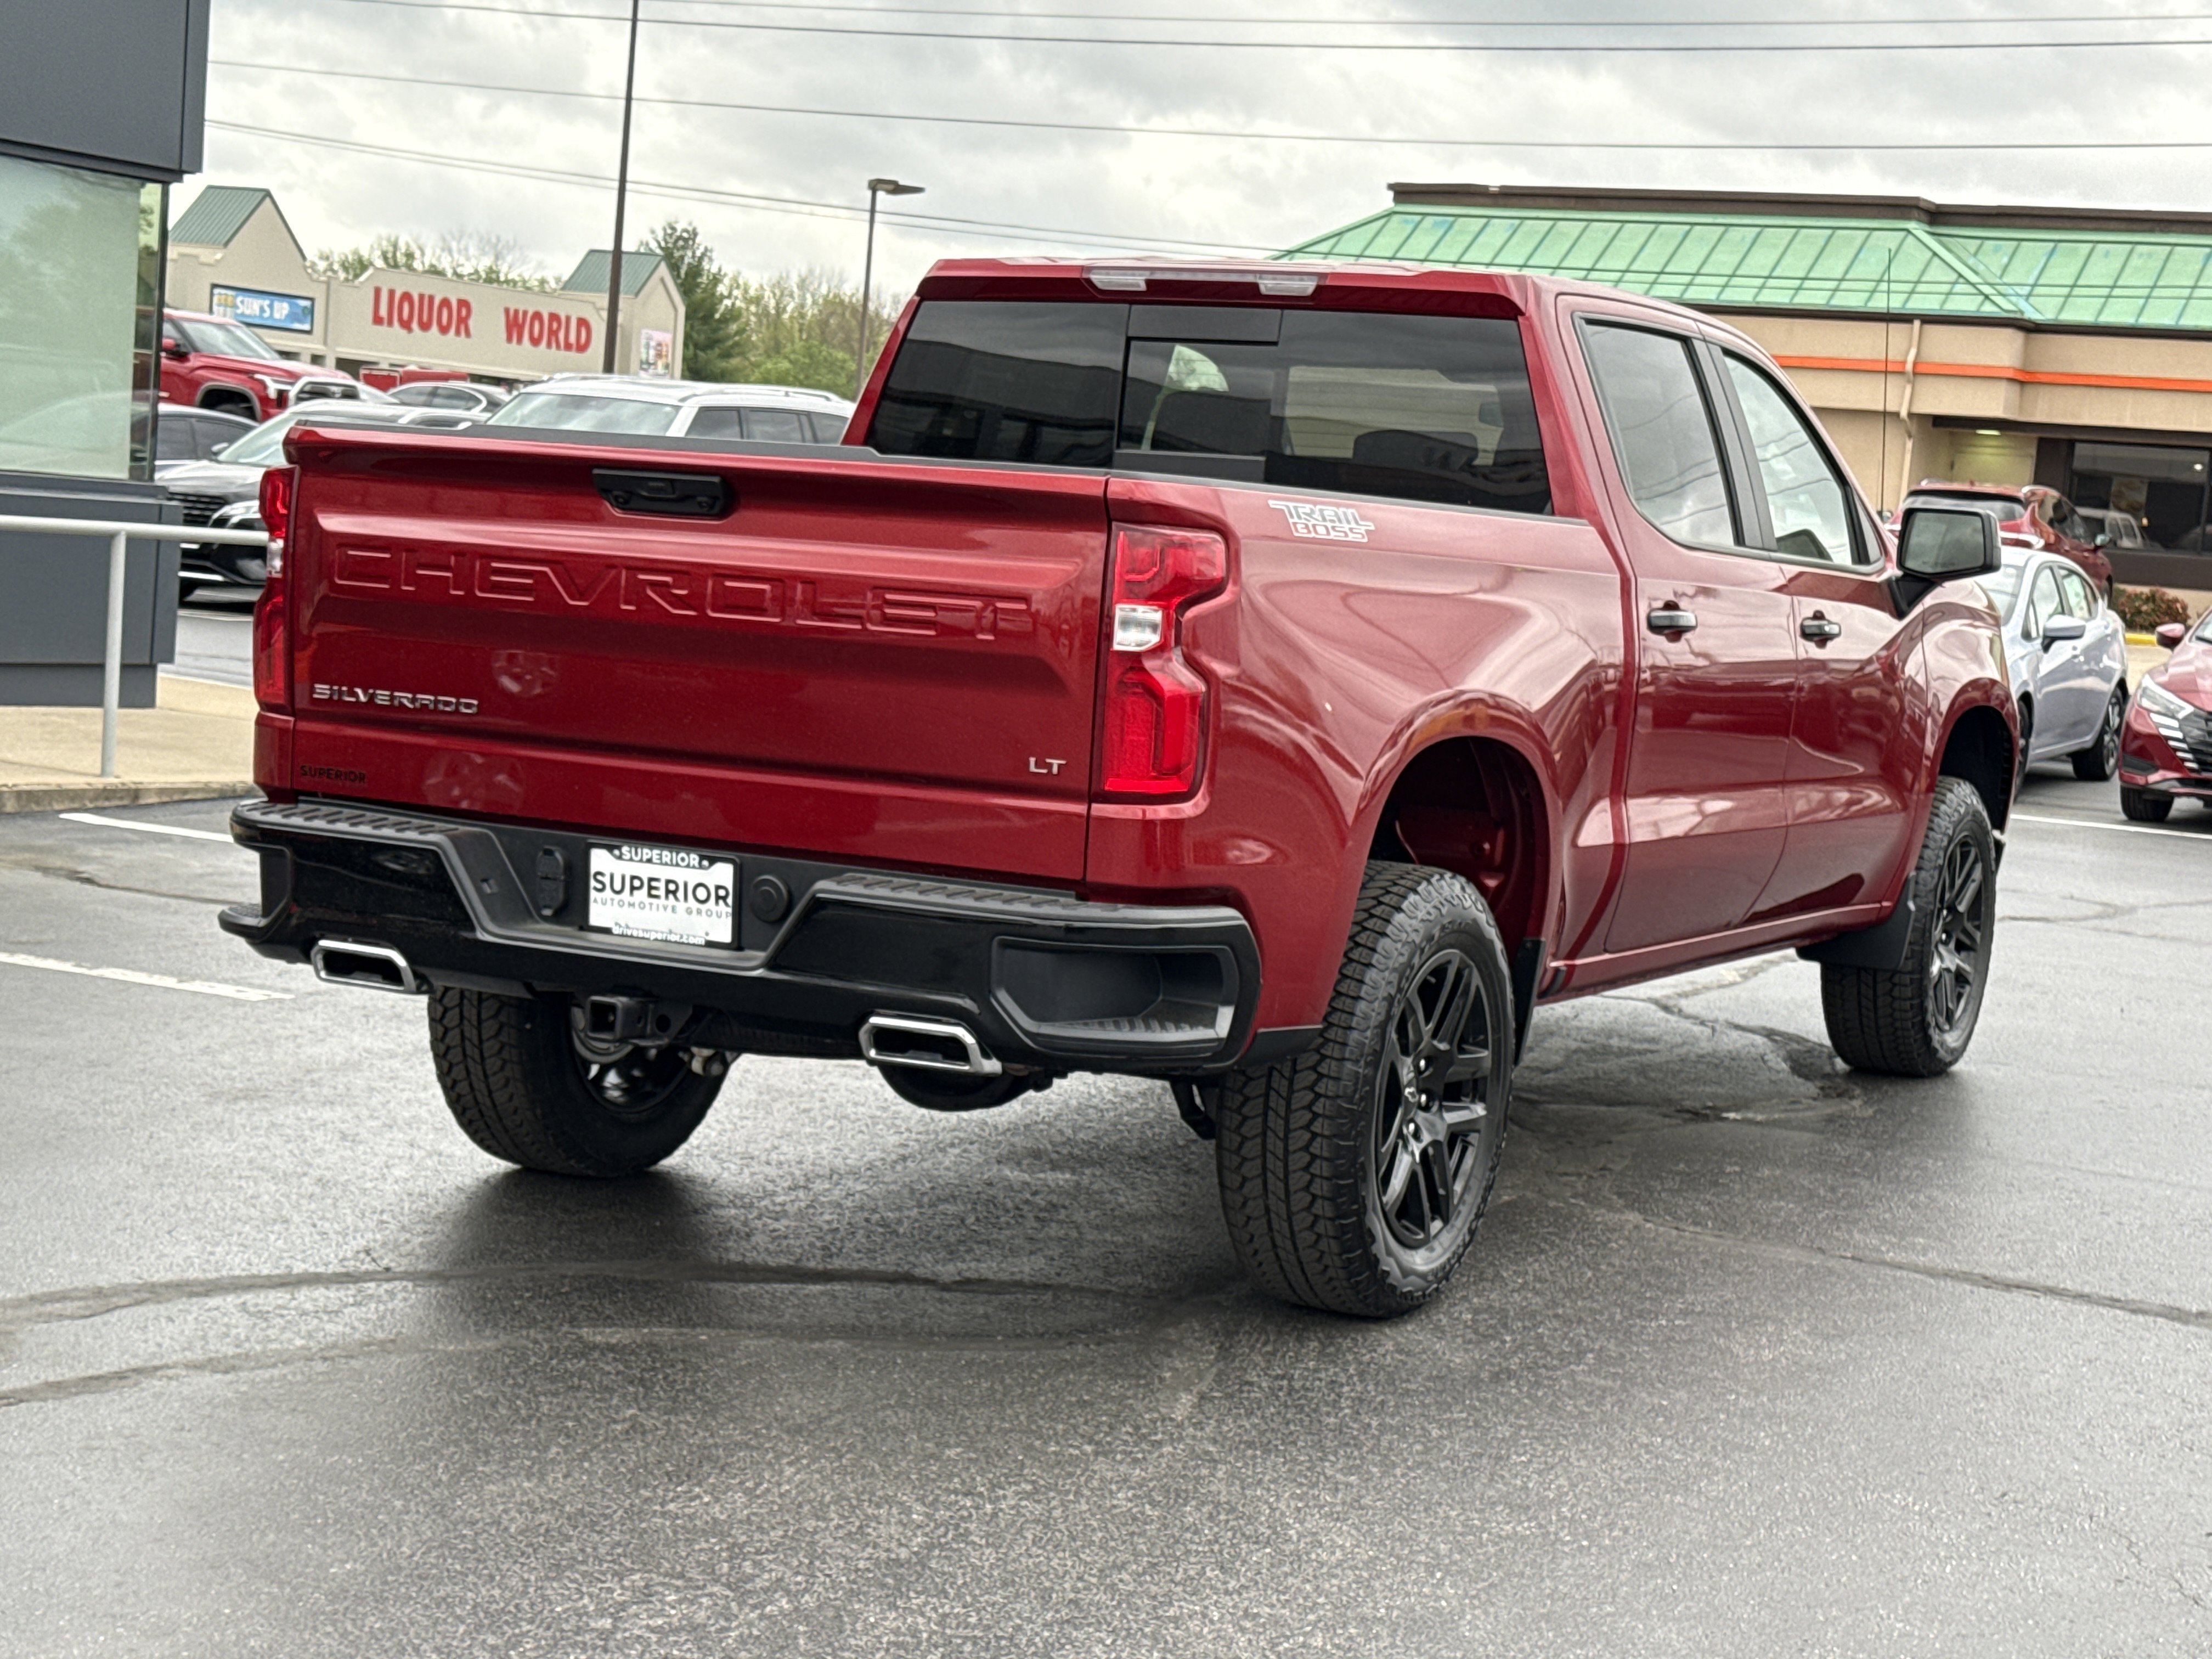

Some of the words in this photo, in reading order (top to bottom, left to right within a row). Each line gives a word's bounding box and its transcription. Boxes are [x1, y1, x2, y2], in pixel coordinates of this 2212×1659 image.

[235, 296, 270, 318] SUN'S
[273, 301, 289, 320] UP
[371, 286, 472, 338] LIQUOR
[504, 307, 592, 354] WORLD
[1267, 499, 1375, 531] TRAIL
[1290, 521, 1368, 543] BOSS
[334, 544, 1034, 641] CHEVROLET
[312, 683, 479, 714] SILVERADO
[300, 765, 366, 789] SUPERIOR
[1029, 757, 1067, 775] LT
[620, 845, 700, 868] SUPERIOR
[592, 871, 732, 908] SUPERIOR
[592, 896, 678, 915] AUTOMOTIVE
[685, 907, 732, 919] GROUP
